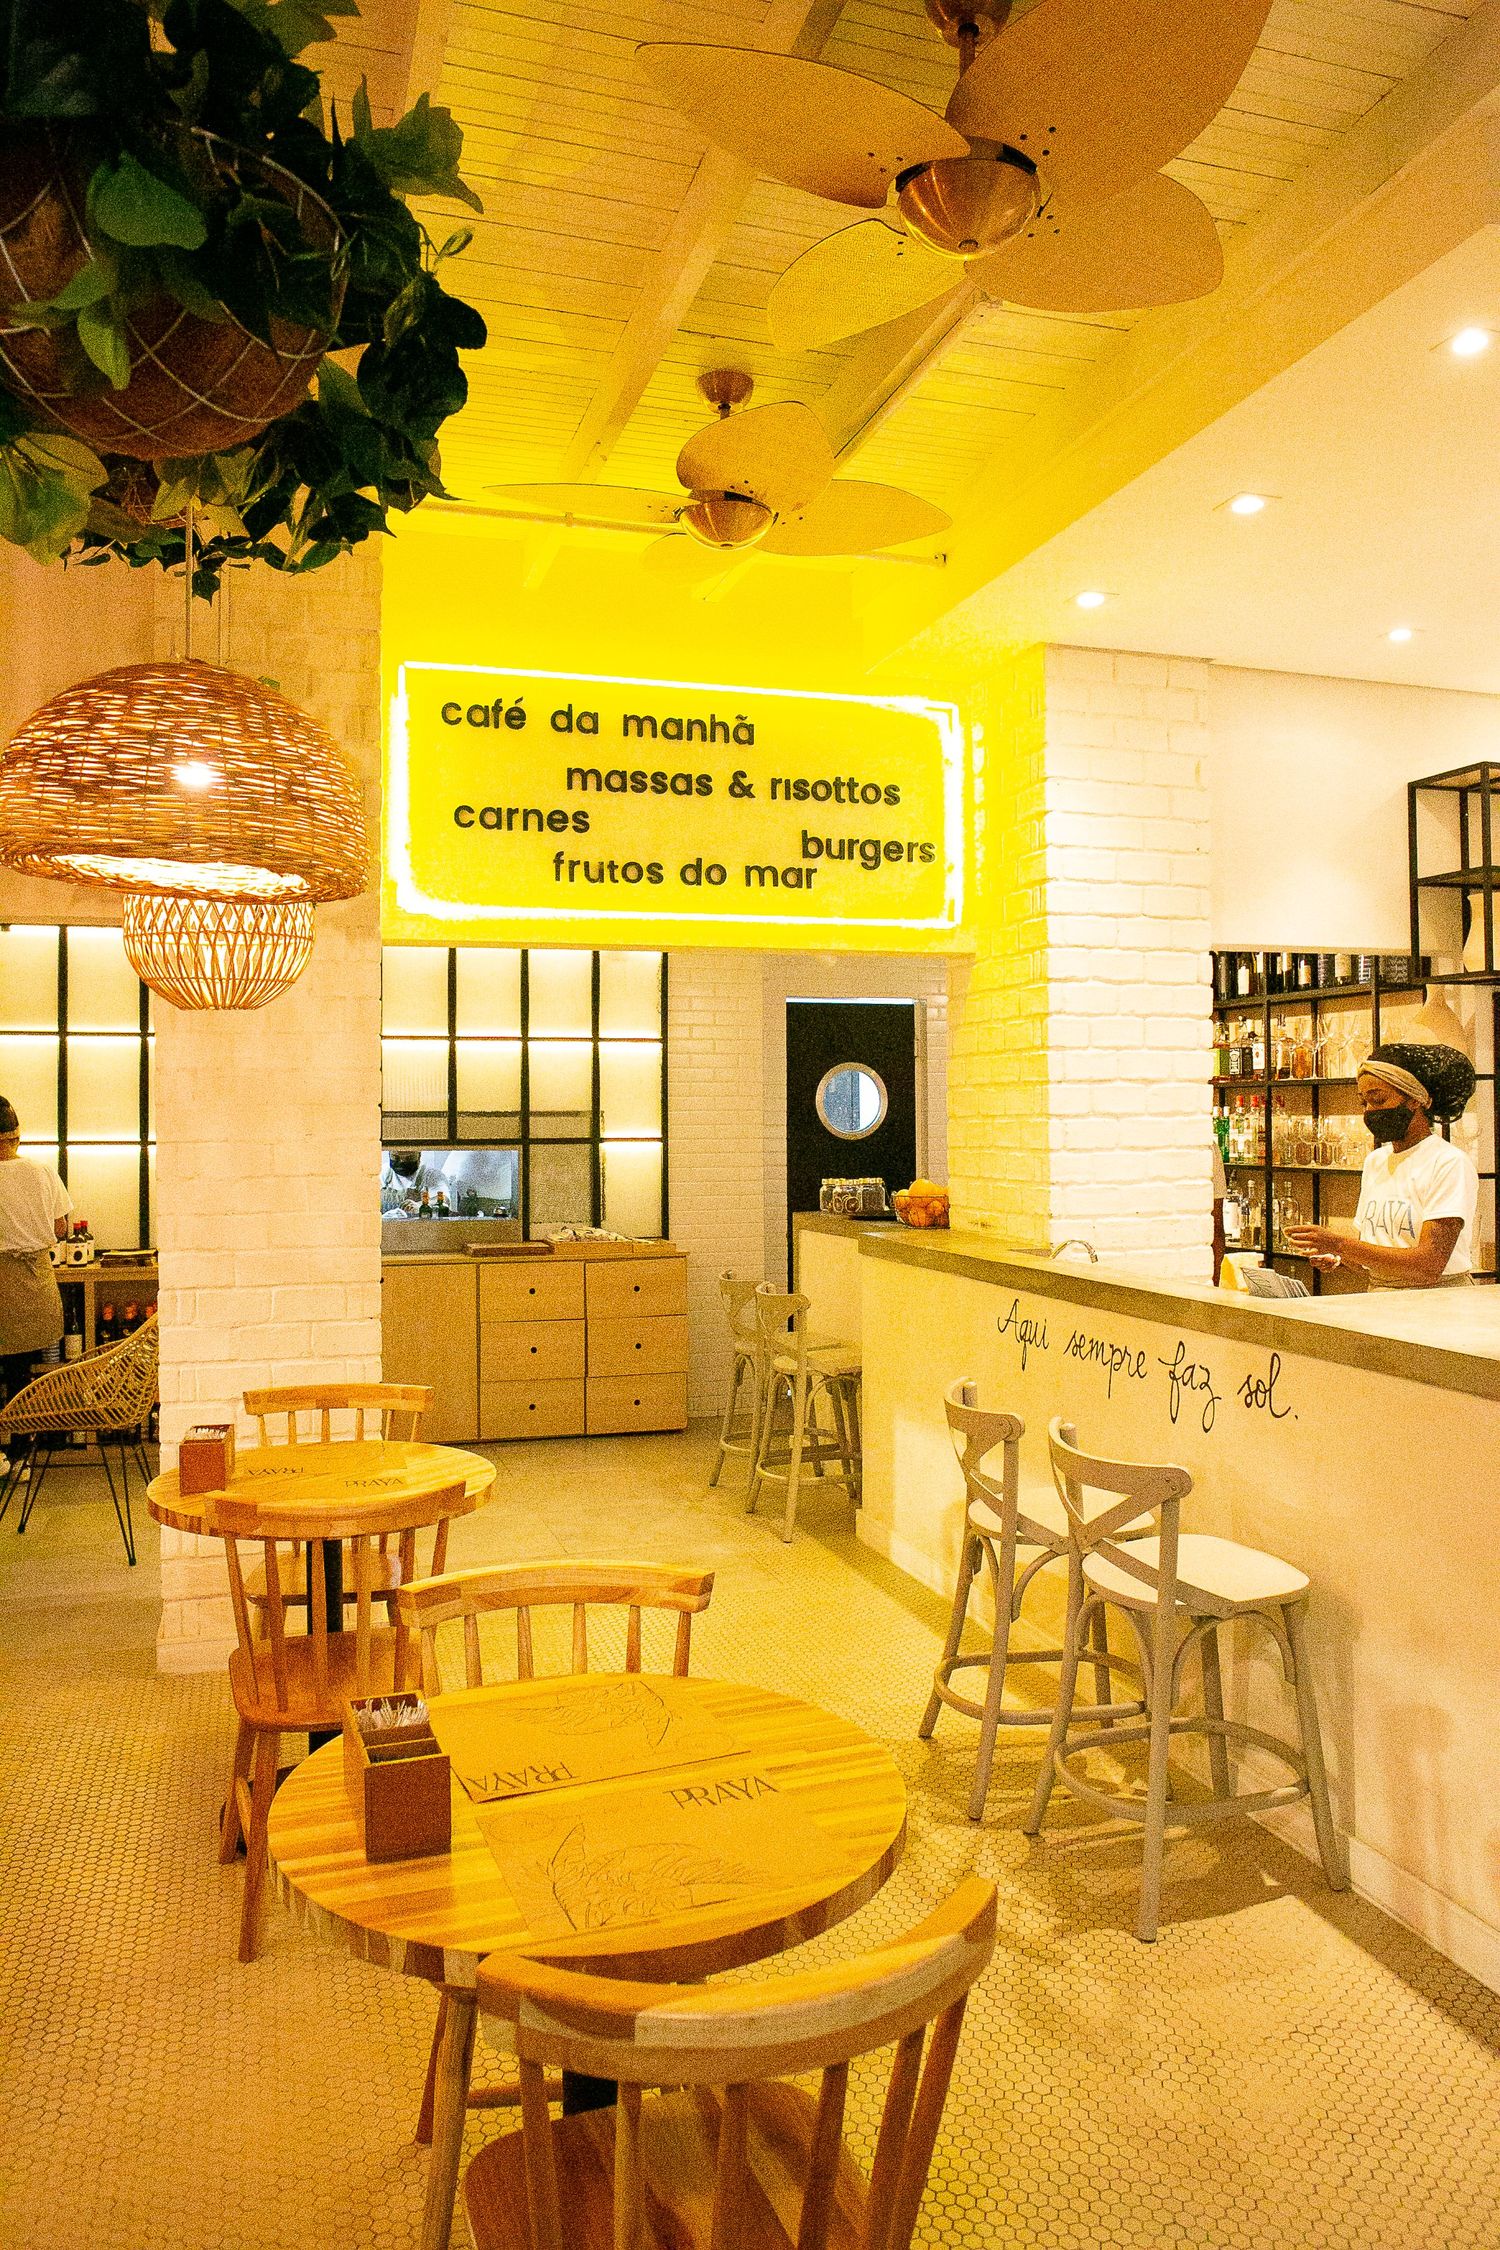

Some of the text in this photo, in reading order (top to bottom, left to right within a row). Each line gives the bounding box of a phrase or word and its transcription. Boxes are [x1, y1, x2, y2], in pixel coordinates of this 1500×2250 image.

[441, 697, 754, 745] café da manhã
[567, 768, 900, 805] massas & risottos
[454, 805, 589, 833] carnes
[801, 830, 935, 871] burgers
[553, 851, 817, 888] frutos do mar
[998, 1299, 1298, 1433] Aqui sempre faz sol.
[466, 1762, 578, 1793] PRAYA
[663, 1776, 779, 1809] PRAYA
